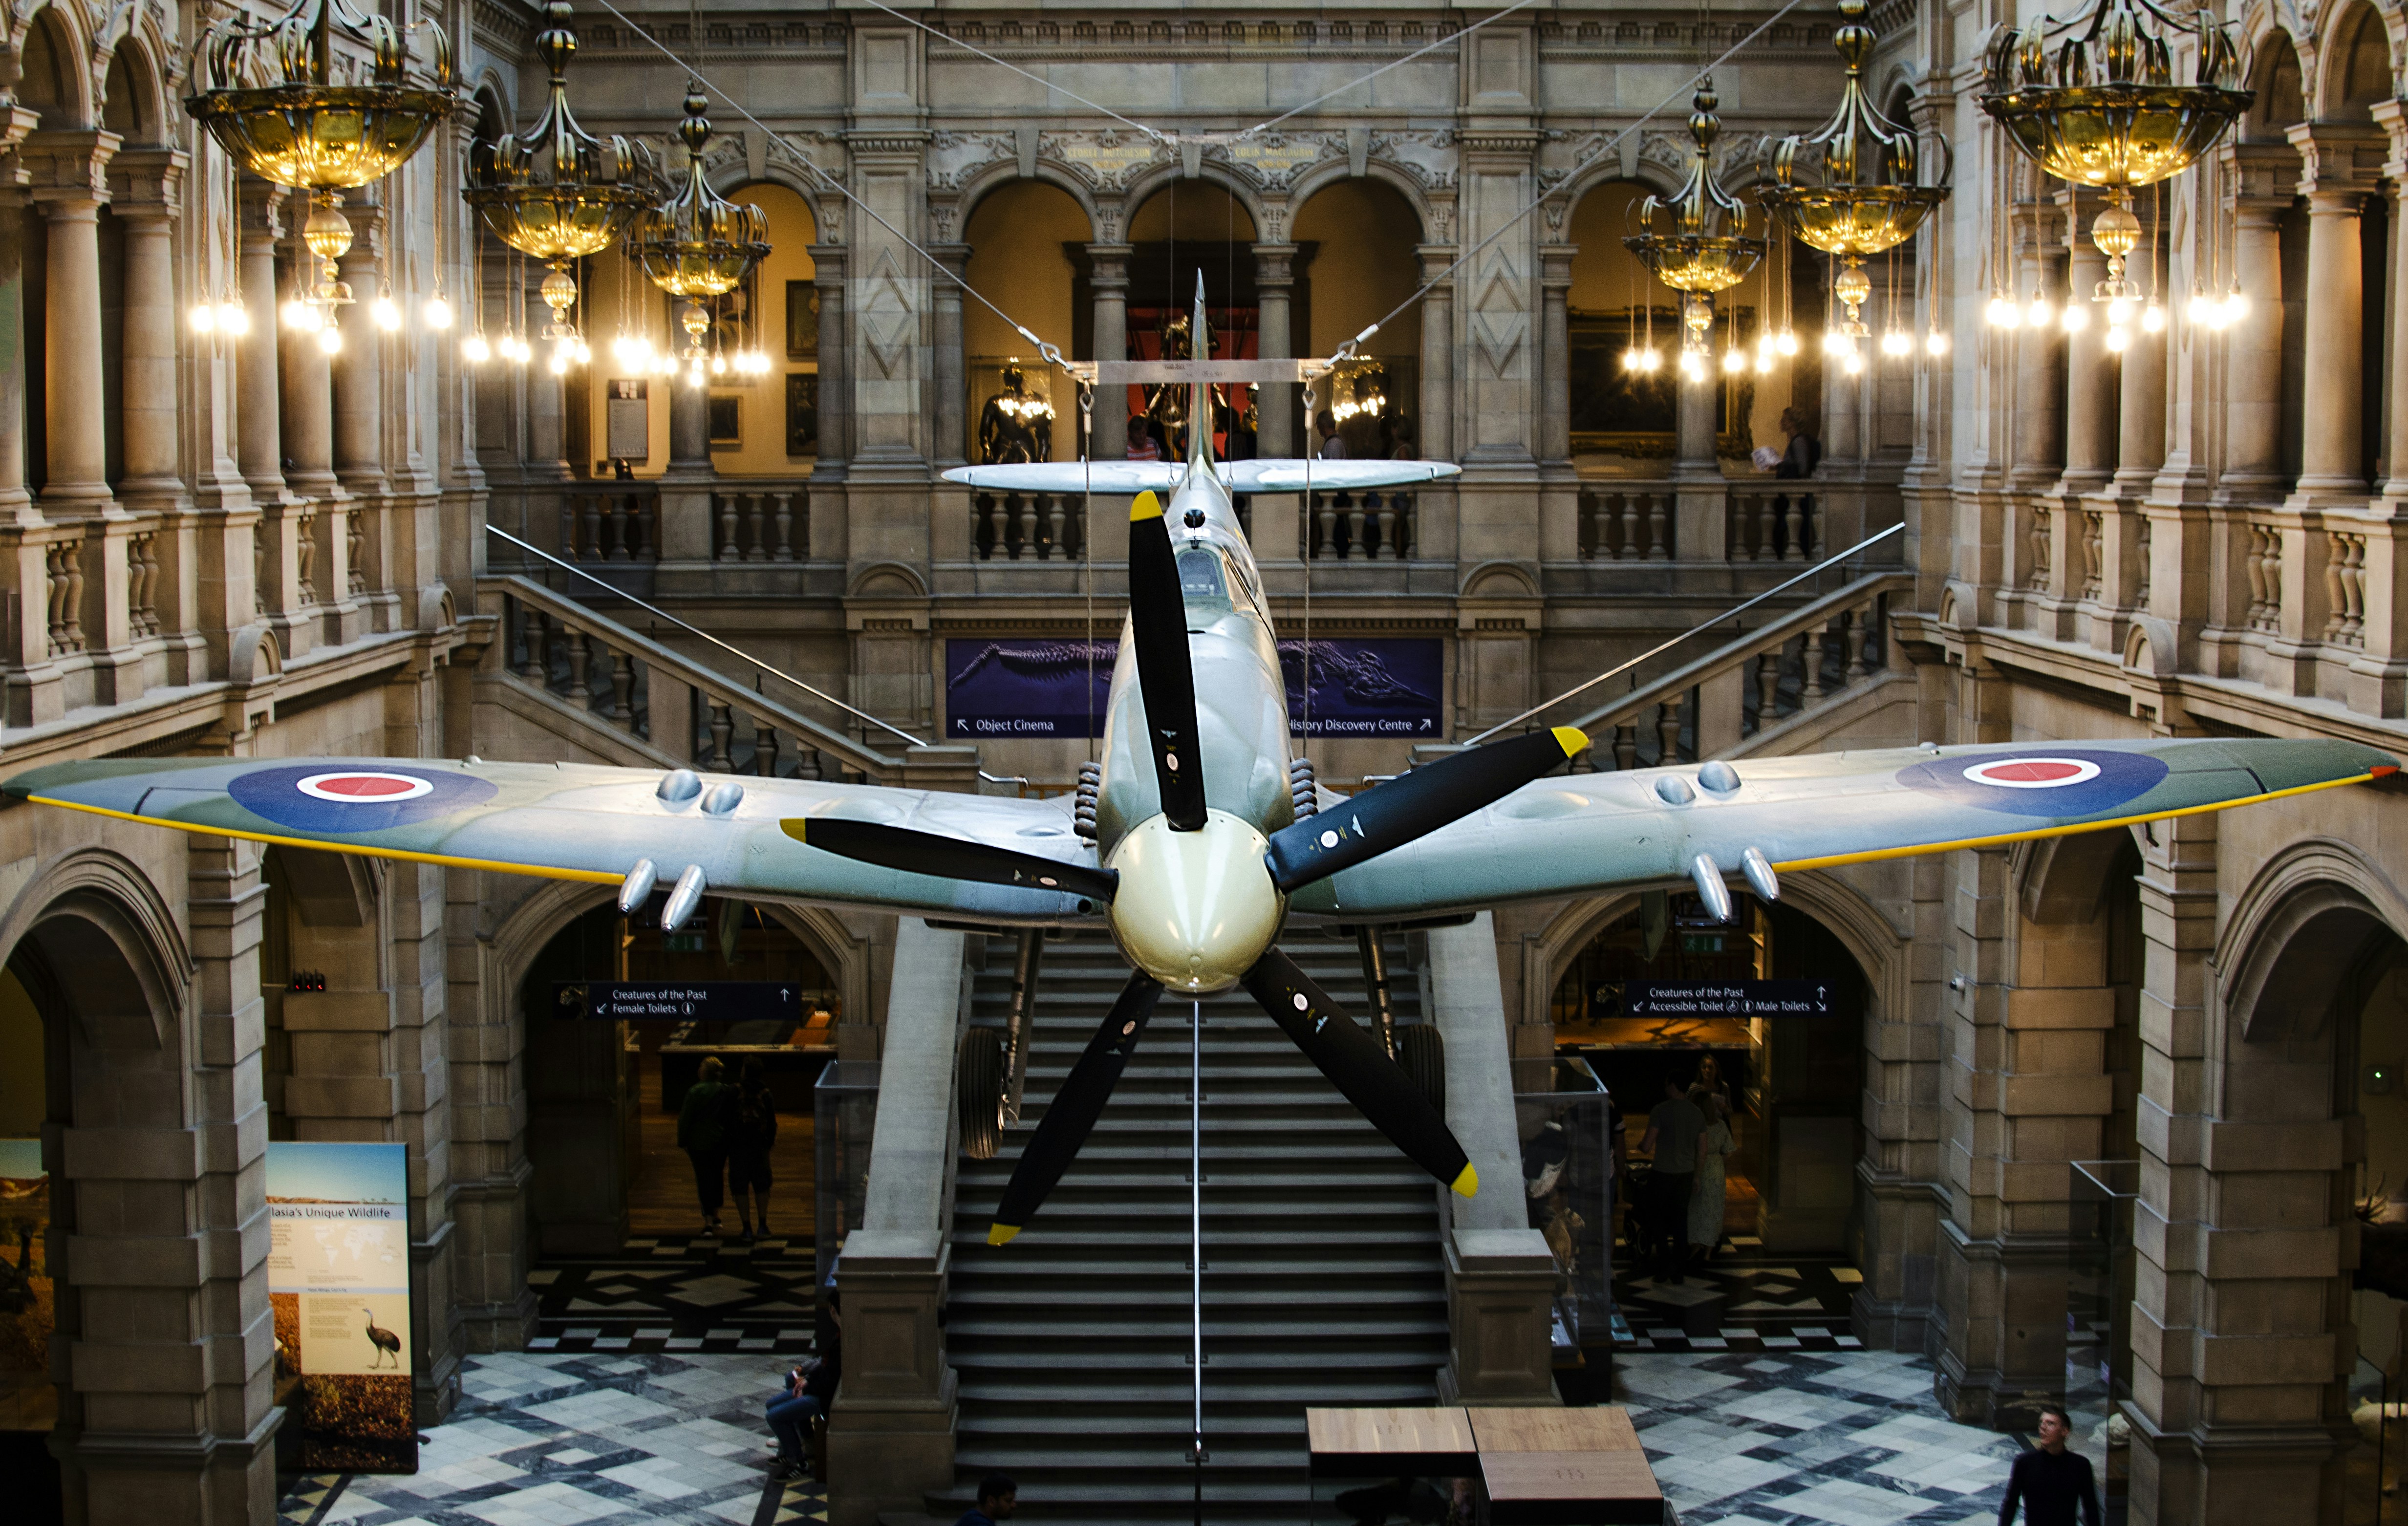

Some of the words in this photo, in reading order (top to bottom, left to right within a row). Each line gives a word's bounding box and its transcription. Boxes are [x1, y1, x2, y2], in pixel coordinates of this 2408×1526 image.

[1235, 148, 1260, 157] COLIN
[976, 719, 1010, 732] Object
[1014, 719, 1054, 731] Cinema
[1326, 719, 1376, 733] Discovery
[1378, 719, 1413, 731] Centre
[613, 989, 657, 1000] Creatures
[658, 989, 668, 1000] of
[670, 989, 685, 1000] the
[687, 990, 707, 1000] Past
[1650, 988, 1694, 998] Creatures
[1696, 988, 1705, 998] of
[1707, 987, 1722, 998] the
[1724, 988, 1744, 998] Past
[613, 1003, 645, 1014] Female
[647, 1003, 677, 1014] Toilets
[1649, 1001, 1697, 1011] Accessible
[1700, 1001, 1723, 1011] Toilet
[1756, 1001, 1778, 1011] Male
[1780, 1001, 1810, 1011] Toilets
[306, 1208, 344, 1219] Unique
[348, 1207, 391, 1218] Wildlife
